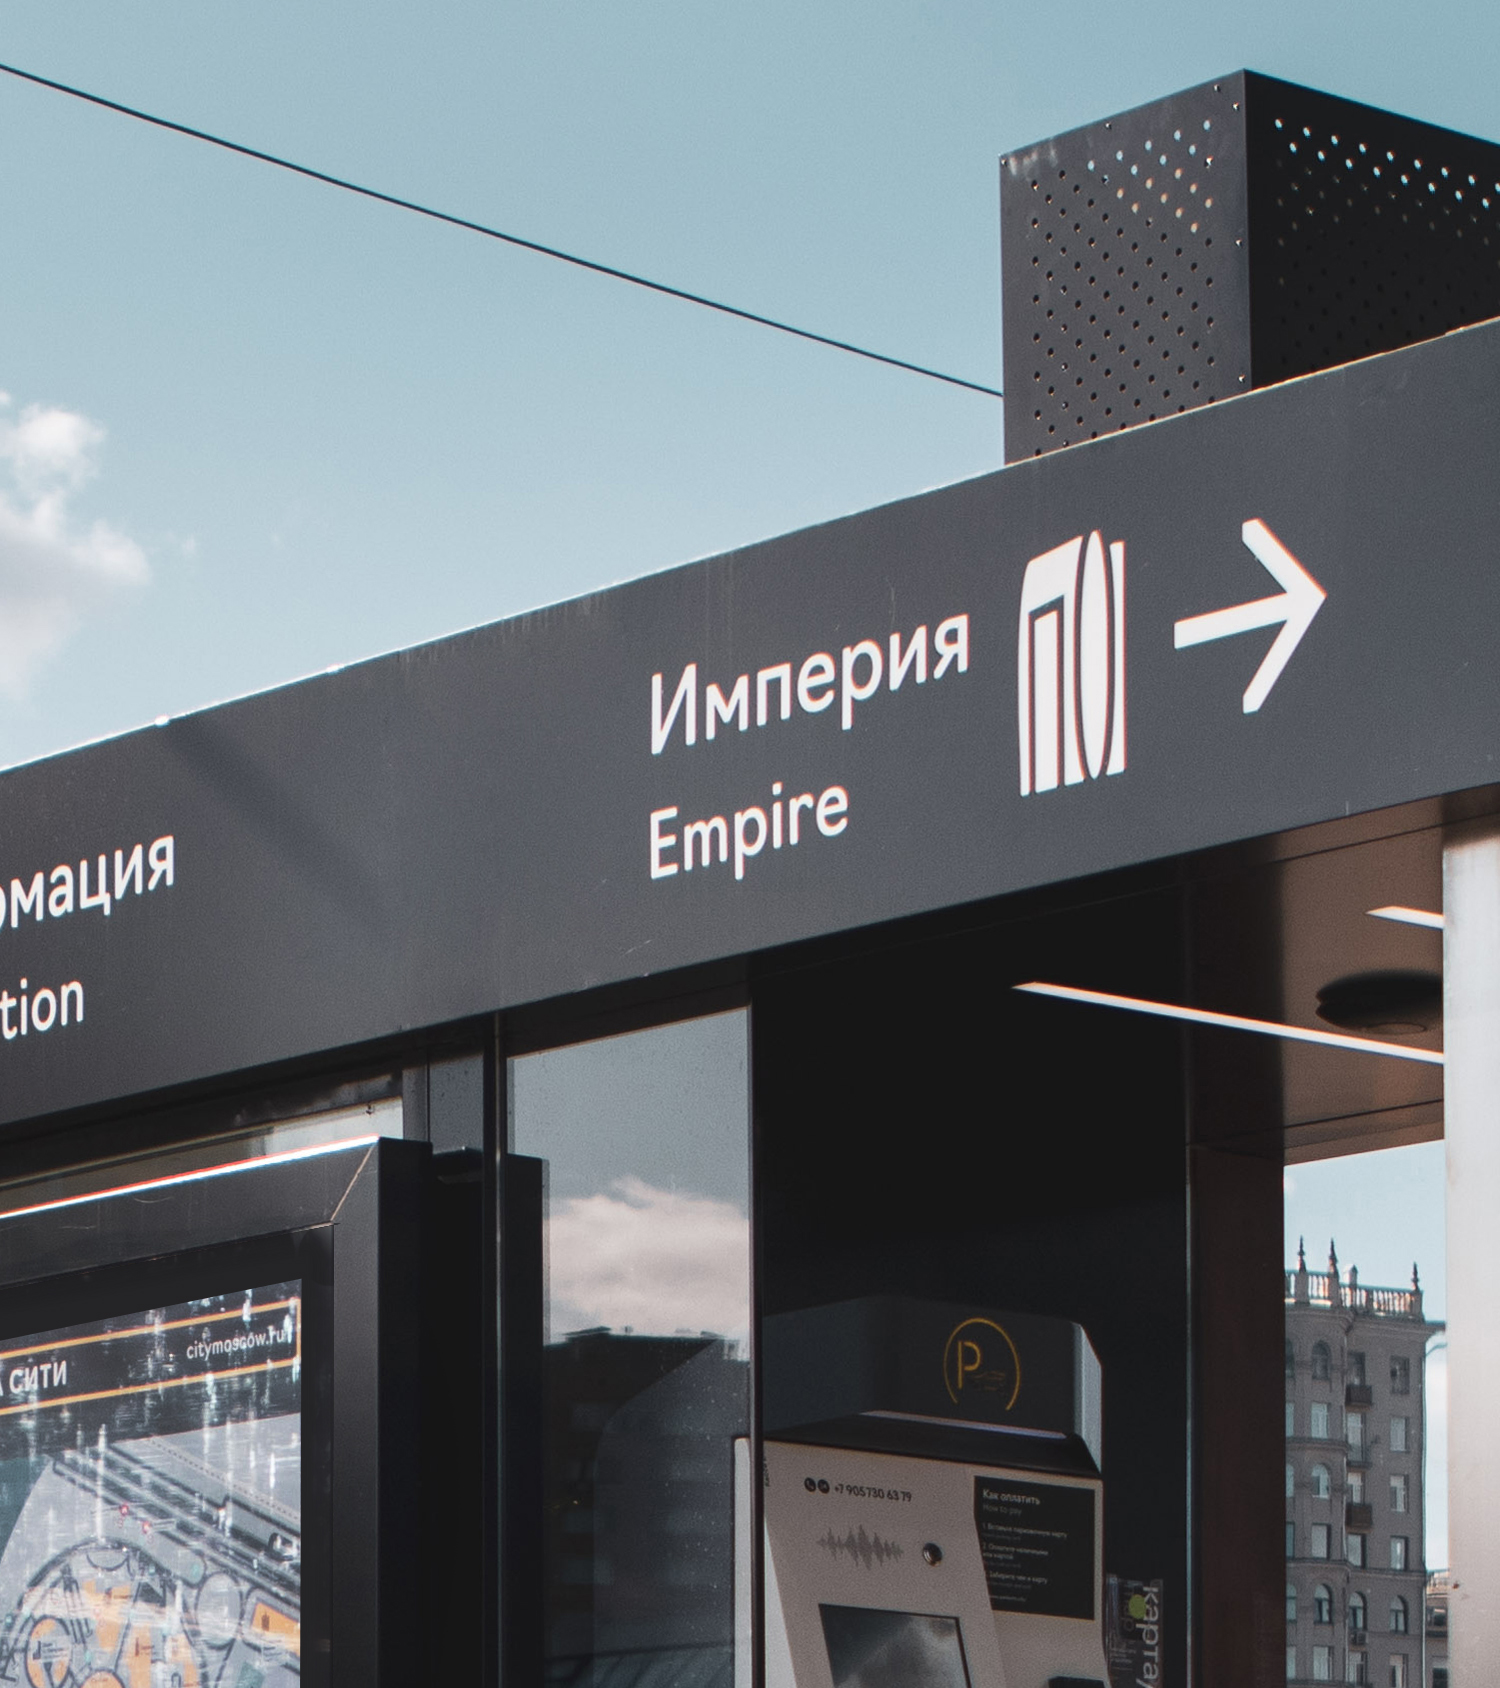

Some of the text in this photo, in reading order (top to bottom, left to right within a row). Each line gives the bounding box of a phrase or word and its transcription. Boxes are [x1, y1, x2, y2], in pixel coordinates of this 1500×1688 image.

[650, 613, 970, 756] Империя
[650, 780, 849, 881] Empire
[187, 1326, 286, 1362] citymoscow.ru
[956, 1340, 982, 1390] P
[8, 1361, 68, 1395] СИТИ
[982, 1488, 1041, 1506] Как оплатить
